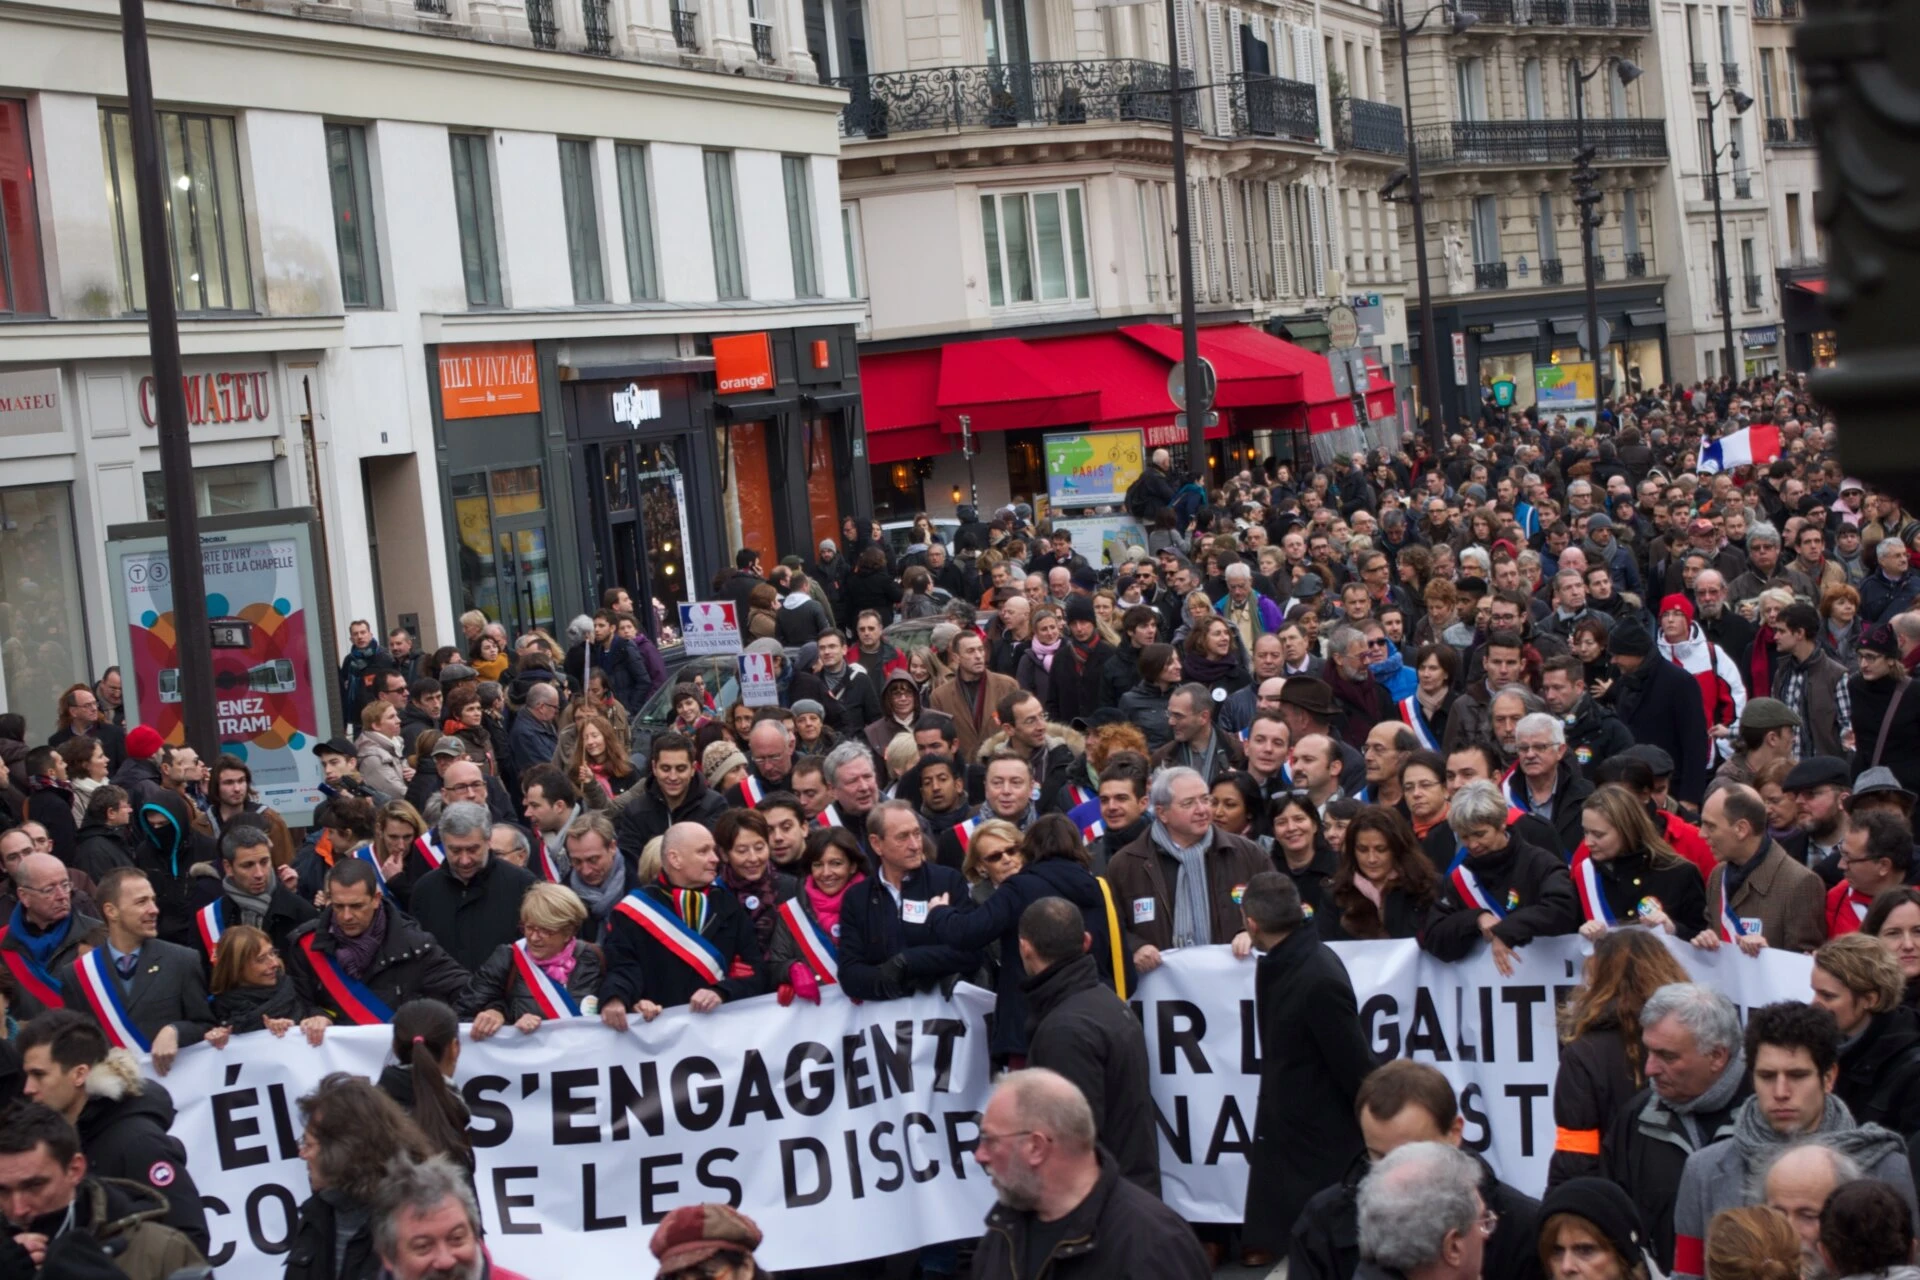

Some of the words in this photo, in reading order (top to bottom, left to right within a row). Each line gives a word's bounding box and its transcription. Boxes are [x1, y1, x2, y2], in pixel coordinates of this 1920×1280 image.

[440, 357, 473, 388] TILT
[476, 354, 534, 387] VINTAGE
[720, 375, 765, 389] orange
[1072, 464, 1104, 478] PARIS
[201, 549, 220, 560] RTE
[222, 547, 251, 560] D'IVRY
[203, 562, 221, 575] RTE
[223, 562, 234, 573] DE
[236, 561, 249, 572] LA
[250, 556, 293, 571] CHAPELLE
[225, 629, 233, 643] 8
[218, 698, 263, 716] ENEZ
[218, 715, 271, 734] TRAM!
[461, 1018, 966, 1149] S'ENGAGENT
[582, 1147, 742, 1232] LES
